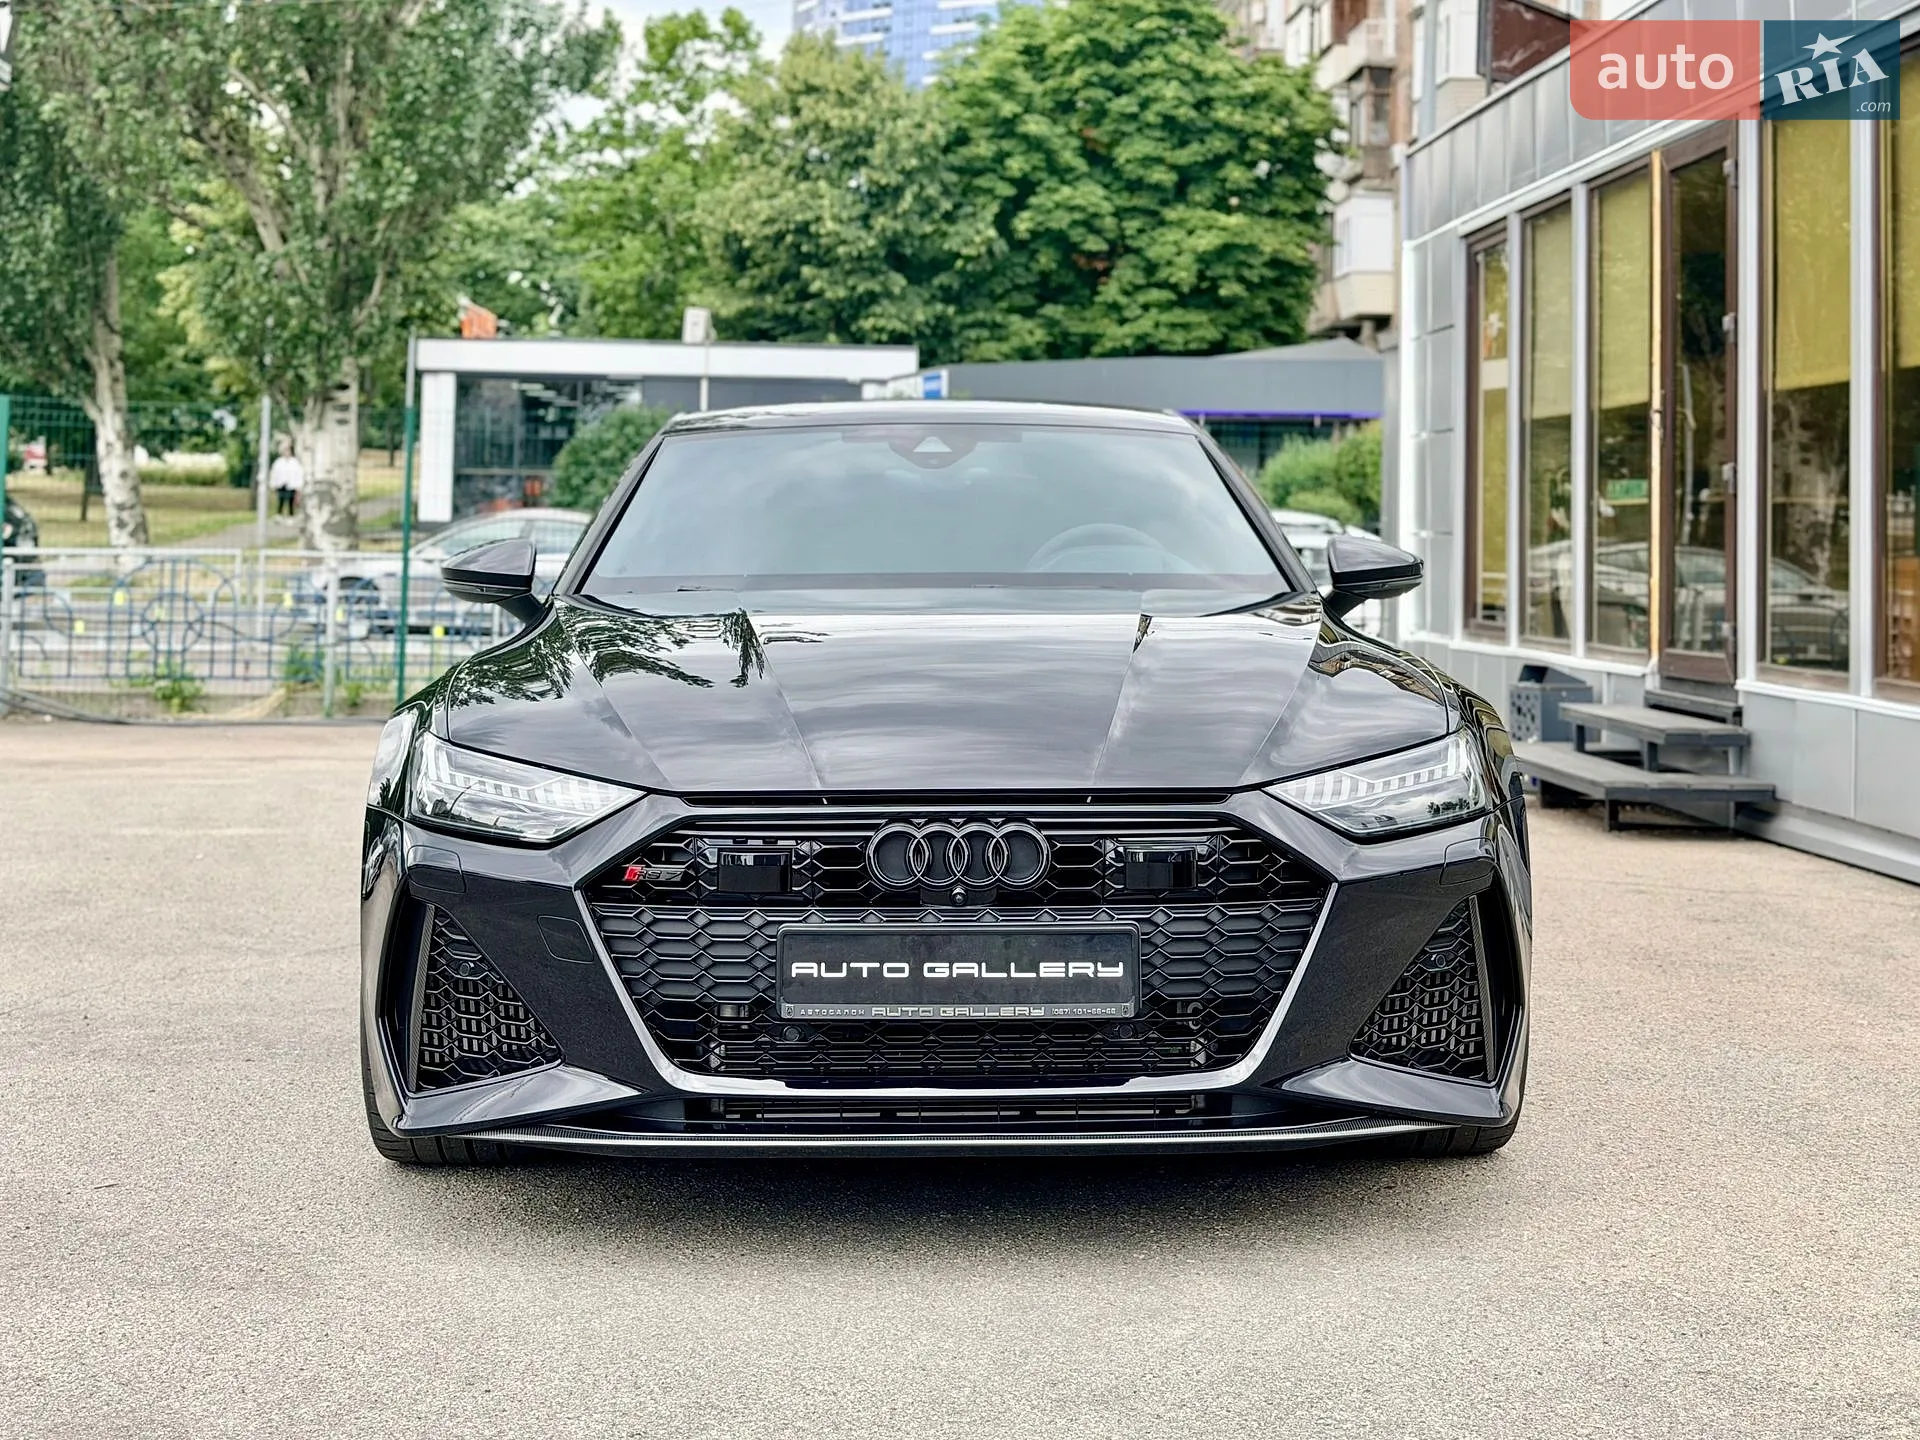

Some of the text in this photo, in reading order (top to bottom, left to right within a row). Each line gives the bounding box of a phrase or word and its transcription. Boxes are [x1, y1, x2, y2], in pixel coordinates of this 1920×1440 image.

[791, 962, 1124, 978] AUTO GALLERY
[871, 1006, 934, 1017] AUTO
[940, 1006, 1045, 1017] GALLERY
